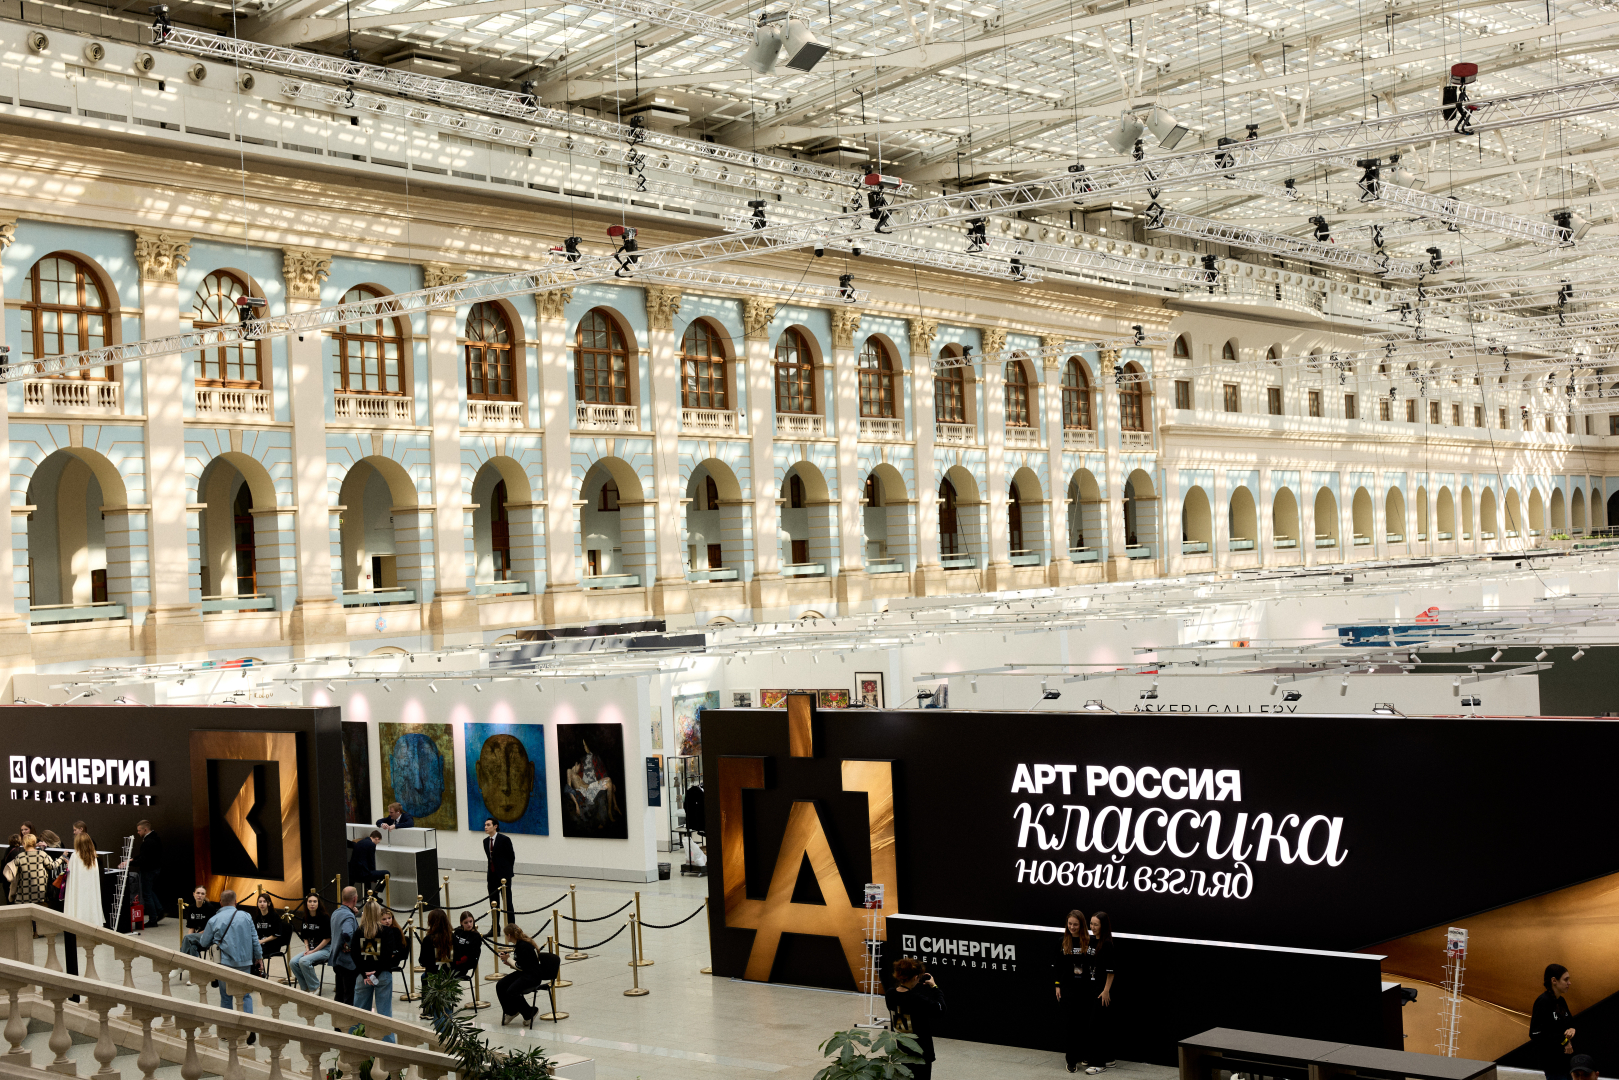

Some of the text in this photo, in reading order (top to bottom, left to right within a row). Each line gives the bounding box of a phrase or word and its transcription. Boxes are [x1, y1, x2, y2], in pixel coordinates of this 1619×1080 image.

[30, 756, 151, 787] СИНЕРГИЯ
[1011, 763, 1242, 801] АРТ РОССИЯ
[10, 789, 152, 806] ПРЕДСТАВЛЯЕТ
[1015, 854, 1254, 899] новый взгляд
[920, 936, 1016, 961] СИНЕРГИЯ
